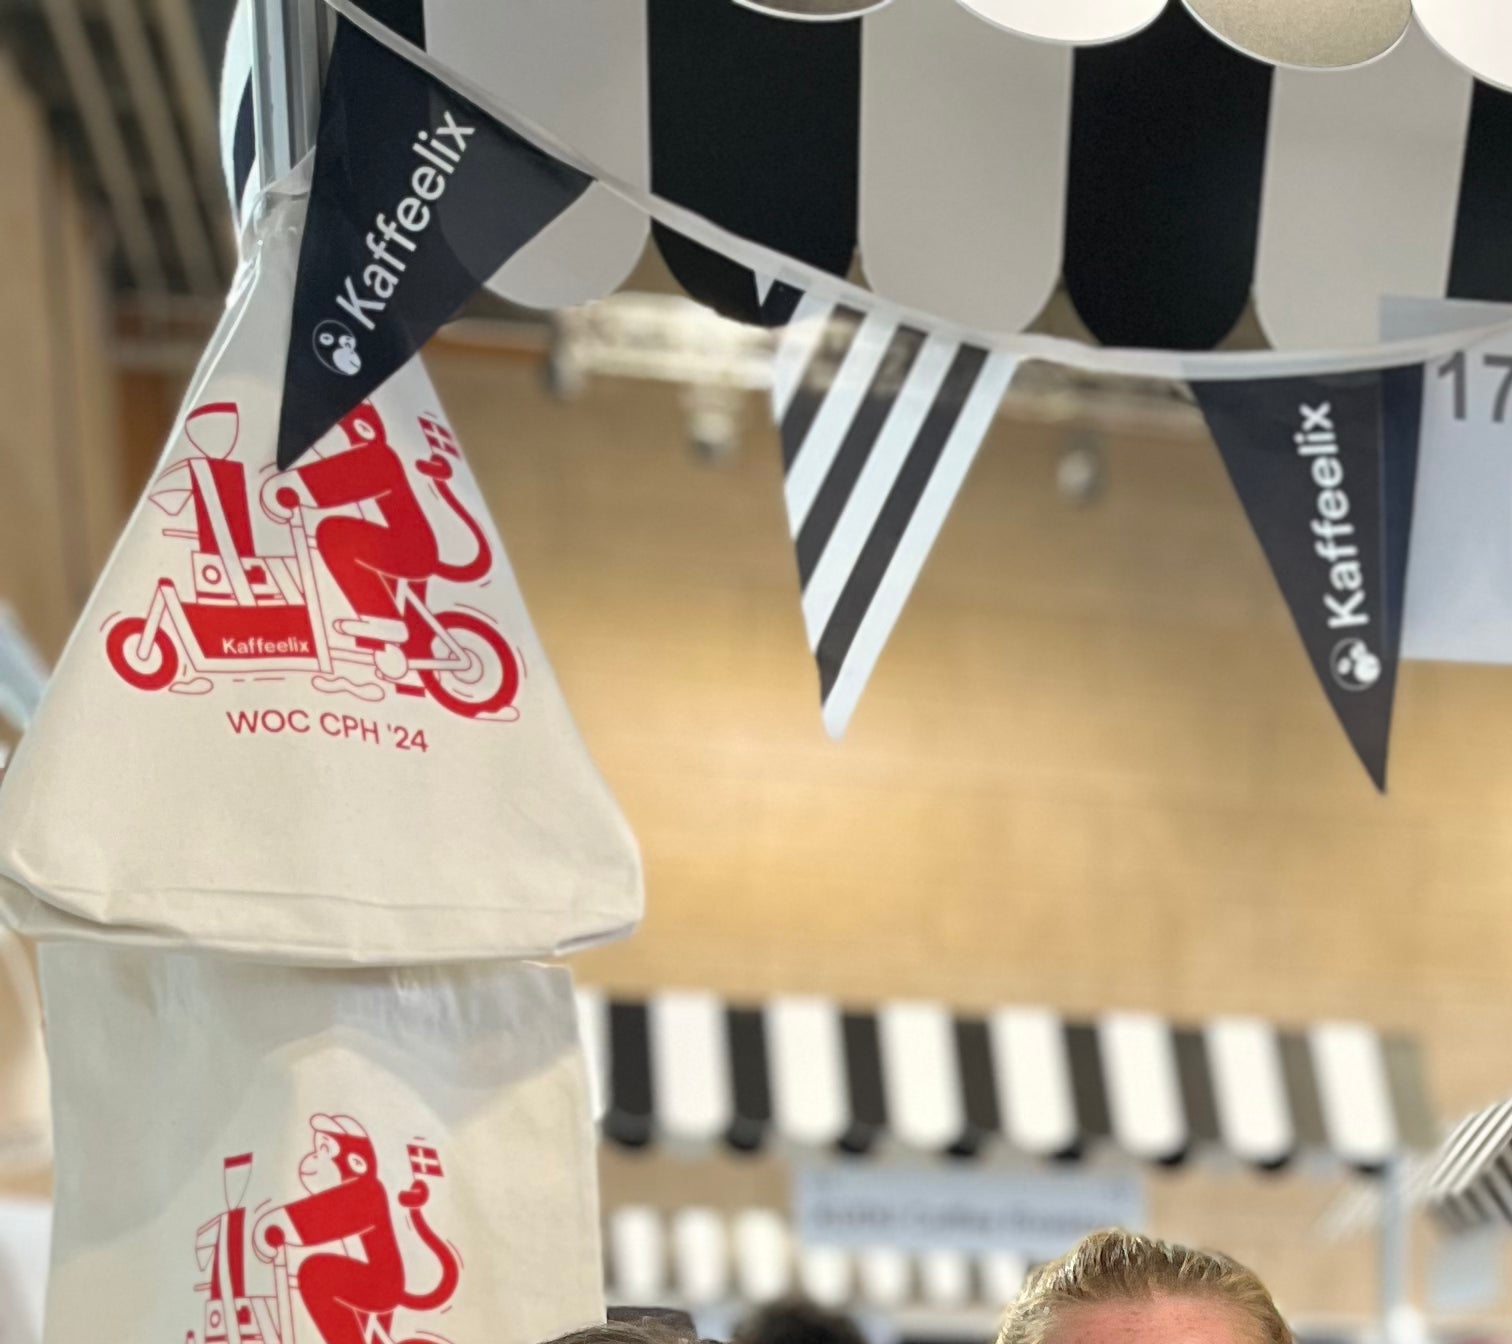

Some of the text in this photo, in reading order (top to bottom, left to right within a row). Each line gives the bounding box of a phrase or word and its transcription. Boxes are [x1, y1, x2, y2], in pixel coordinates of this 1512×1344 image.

[335, 110, 476, 331] Kaffeelix
[1293, 401, 1370, 628] Kaffeelix
[222, 637, 310, 654] Kaffeelix
[226, 709, 429, 752] WOC CPH '24
